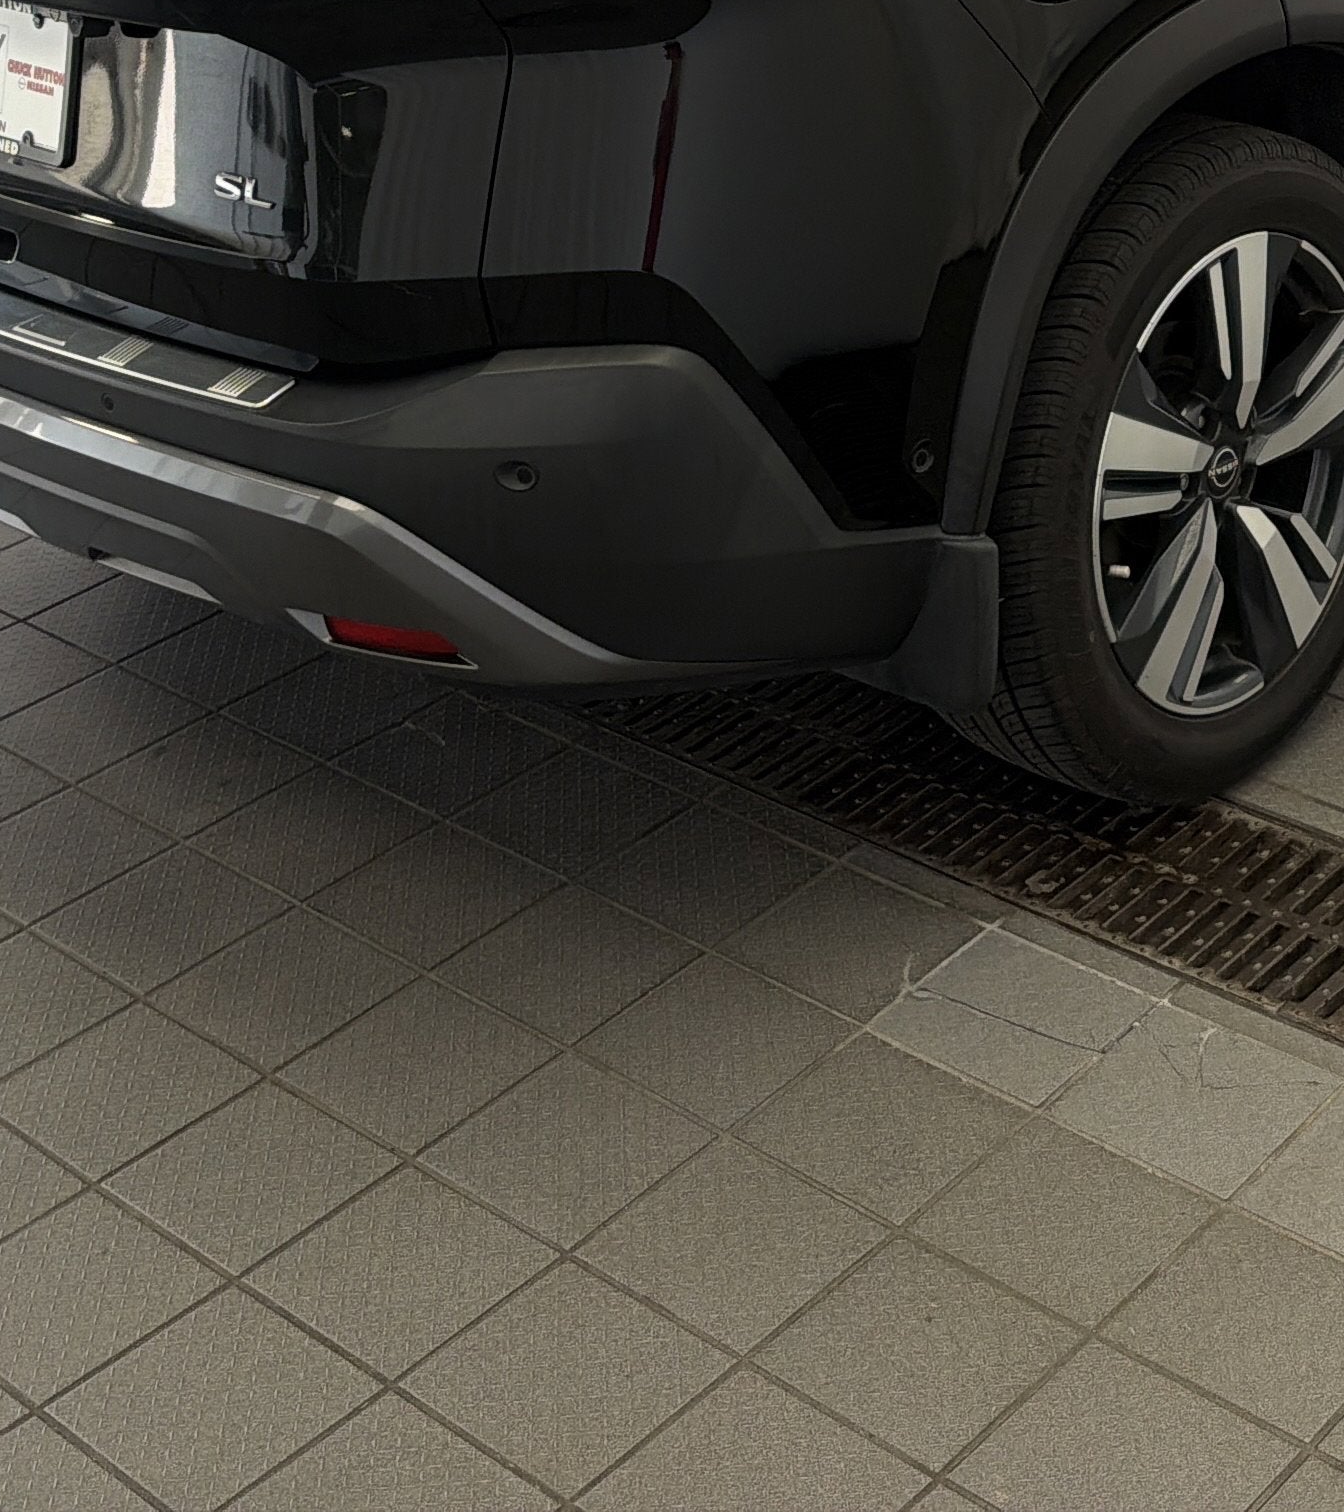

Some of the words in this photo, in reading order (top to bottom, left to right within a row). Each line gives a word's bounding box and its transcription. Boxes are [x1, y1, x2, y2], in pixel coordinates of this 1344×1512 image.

[7, 58, 33, 78] CHUCK
[33, 65, 66, 87] HUTTON
[26, 80, 54, 97] NISSAN
[213, 171, 274, 210] SL
